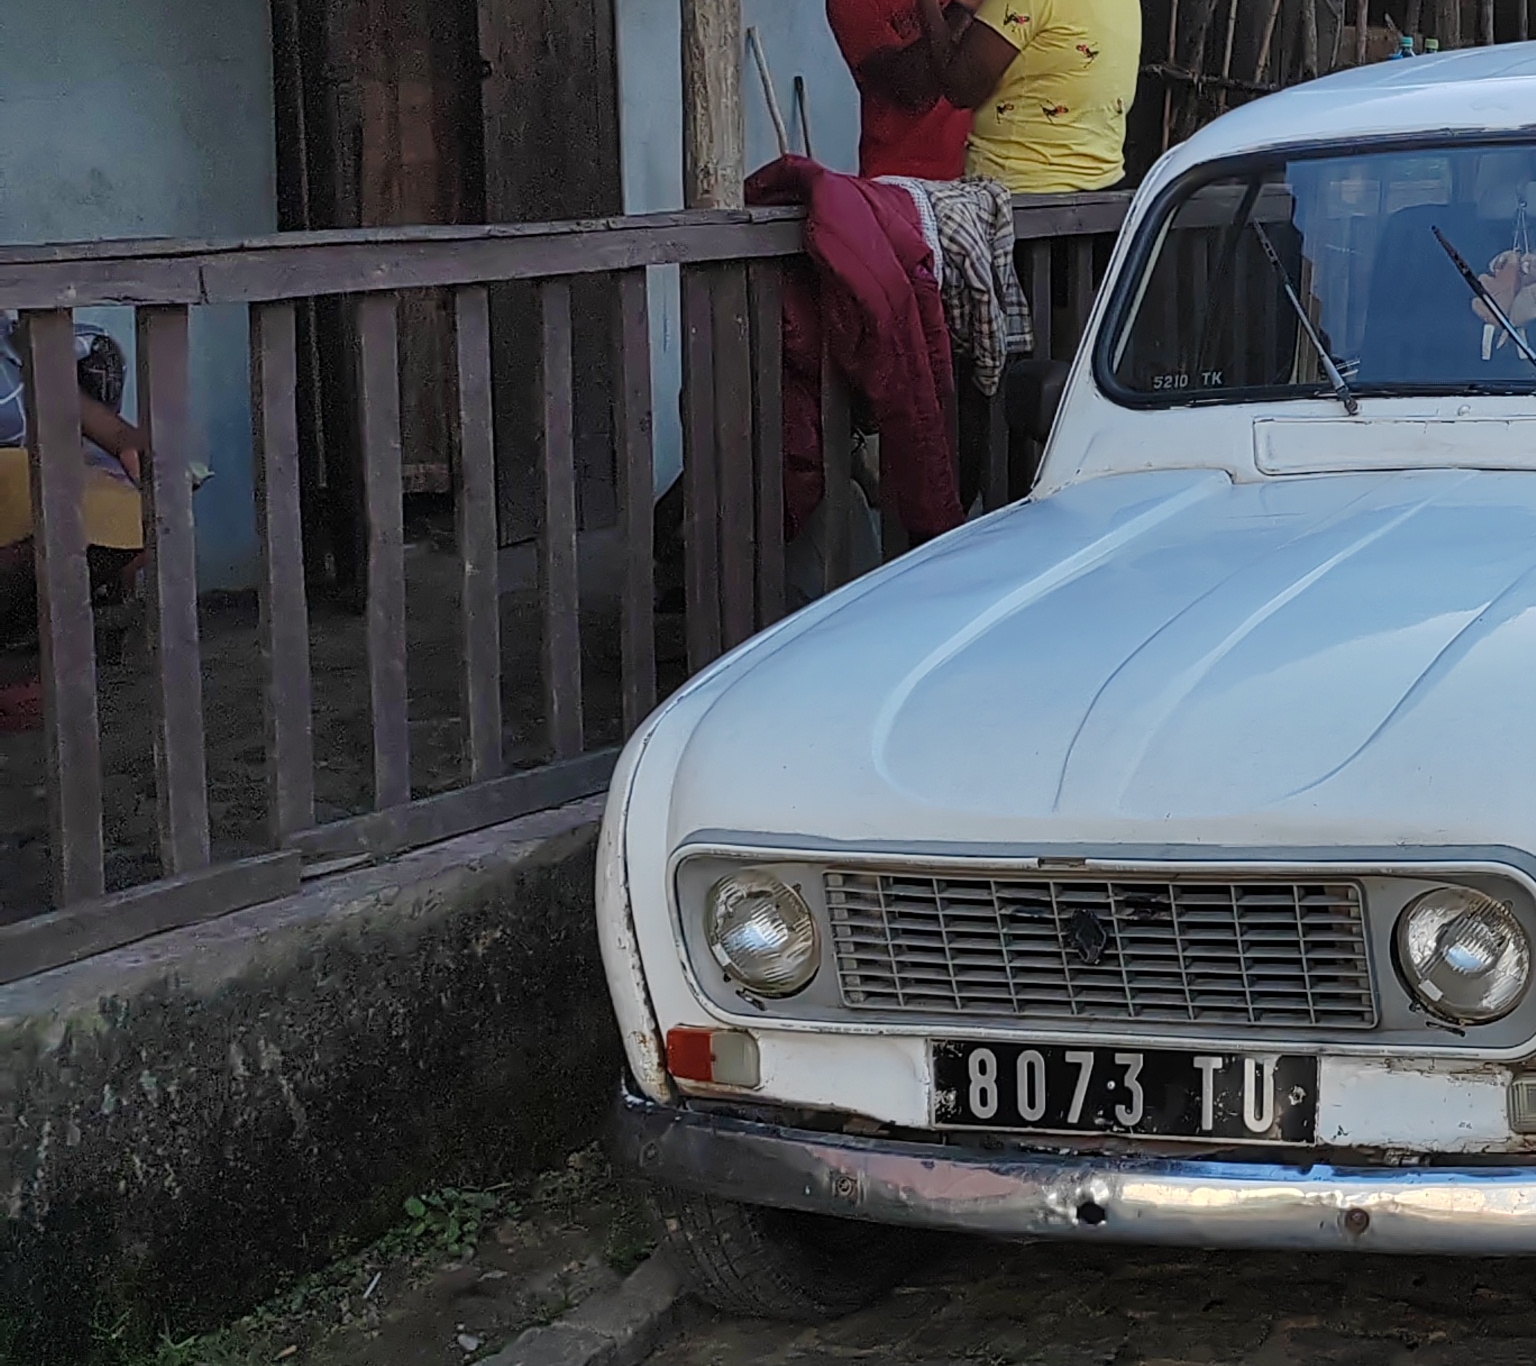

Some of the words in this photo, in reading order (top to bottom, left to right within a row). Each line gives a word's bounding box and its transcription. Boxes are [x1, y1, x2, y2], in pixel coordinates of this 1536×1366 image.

[1153, 374, 1189, 389] 5210
[1201, 371, 1223, 385] TK
[968, 1048, 1144, 1127] 8073
[1193, 1055, 1276, 1133] TU
